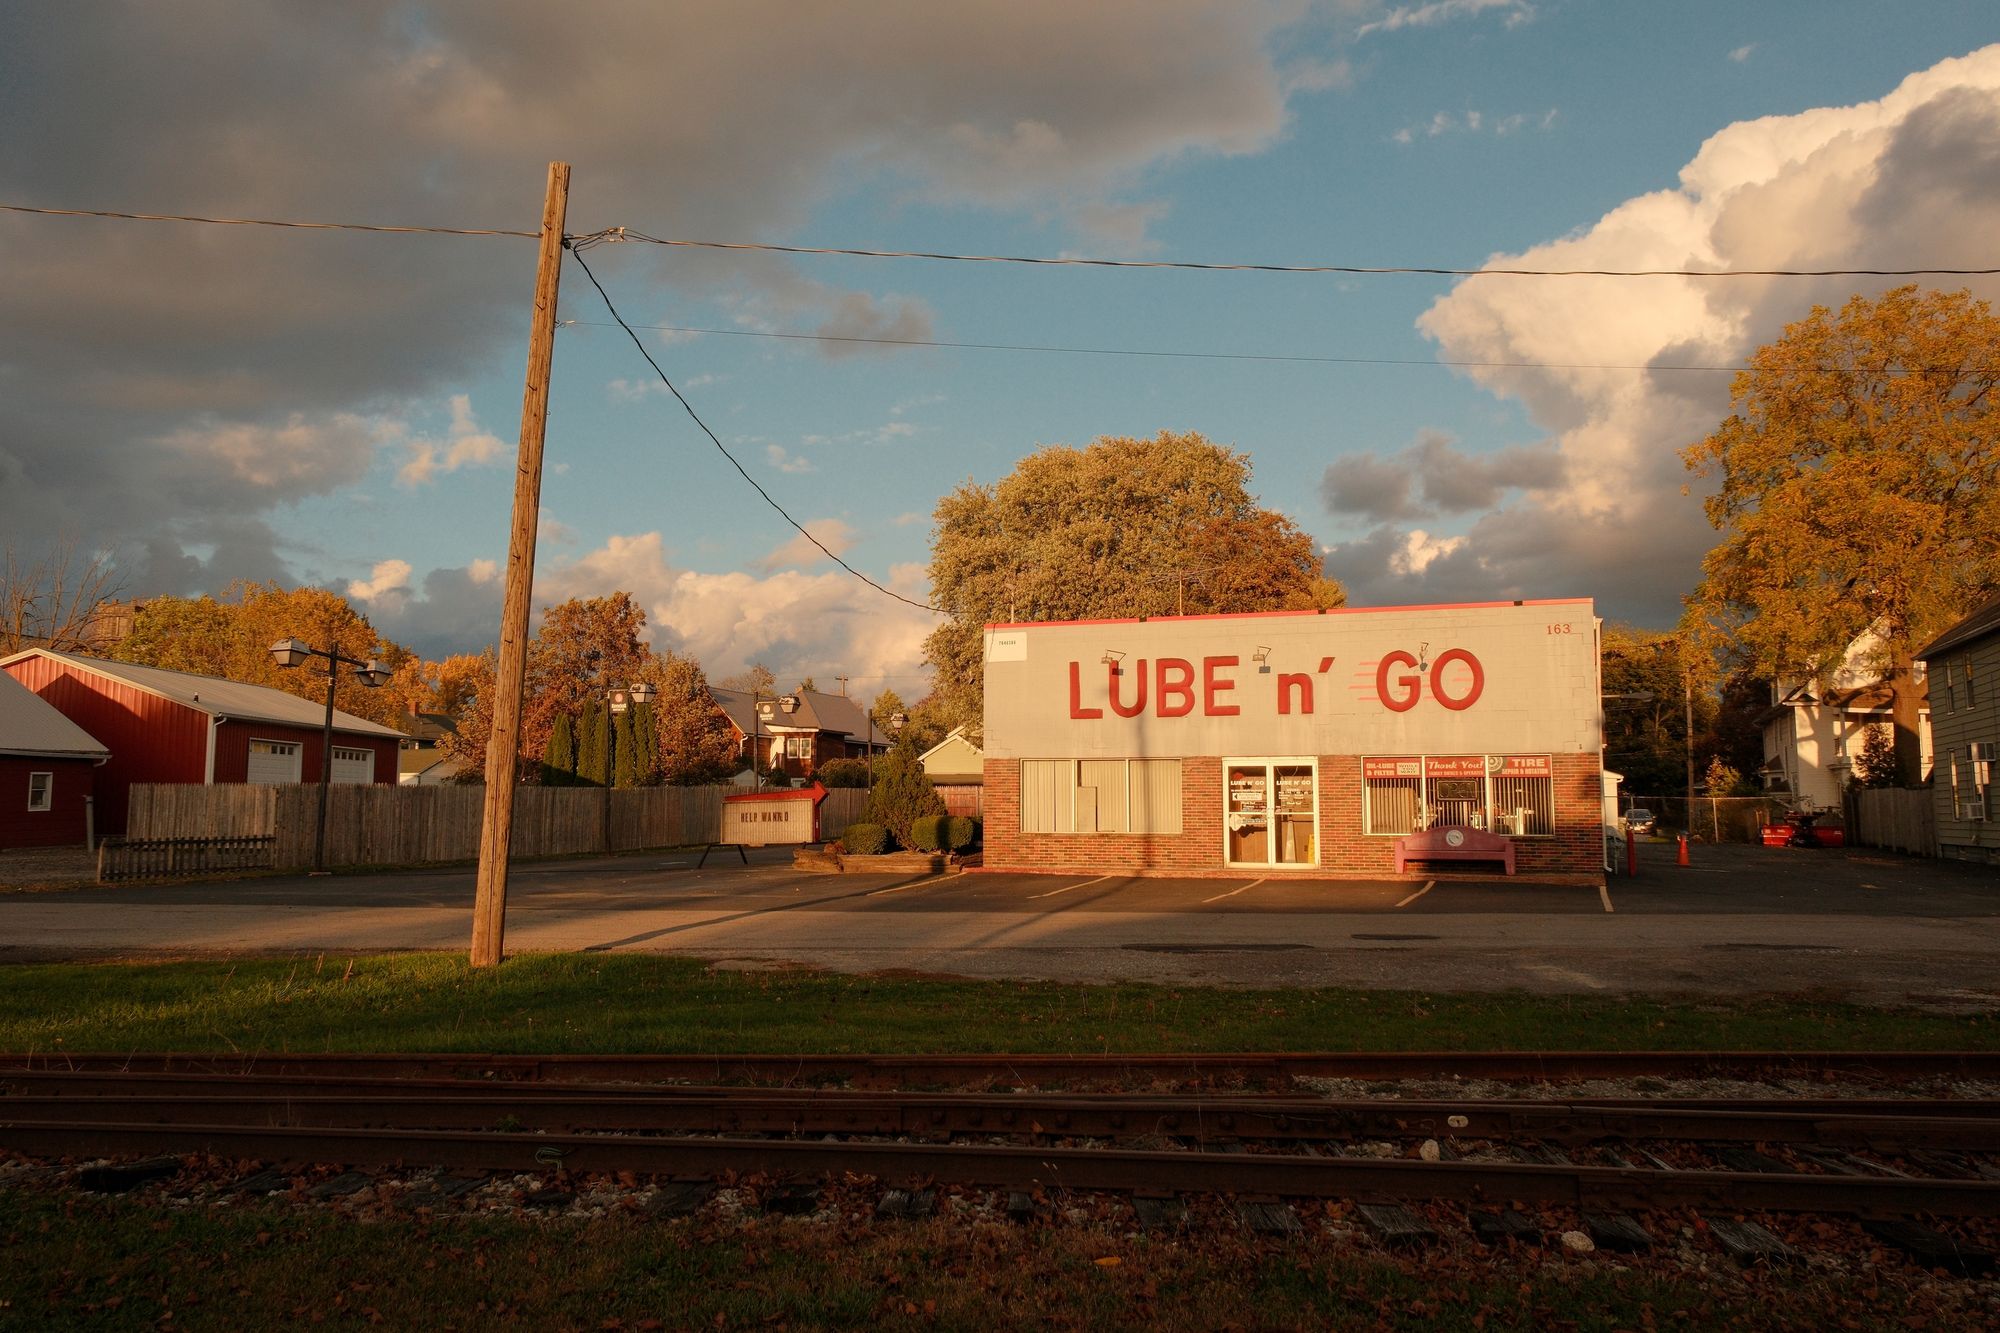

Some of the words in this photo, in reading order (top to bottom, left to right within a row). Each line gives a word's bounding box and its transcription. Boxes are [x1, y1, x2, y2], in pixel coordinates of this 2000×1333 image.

[1547, 624, 1571, 635] 163
[1069, 655, 1240, 719] LUBE
[1376, 648, 1485, 712] GO
[1427, 761, 1457, 769] Thank
[1461, 760, 1484, 769] You!
[1512, 758, 1545, 767] TIRE
[741, 812, 758, 822] HELP
